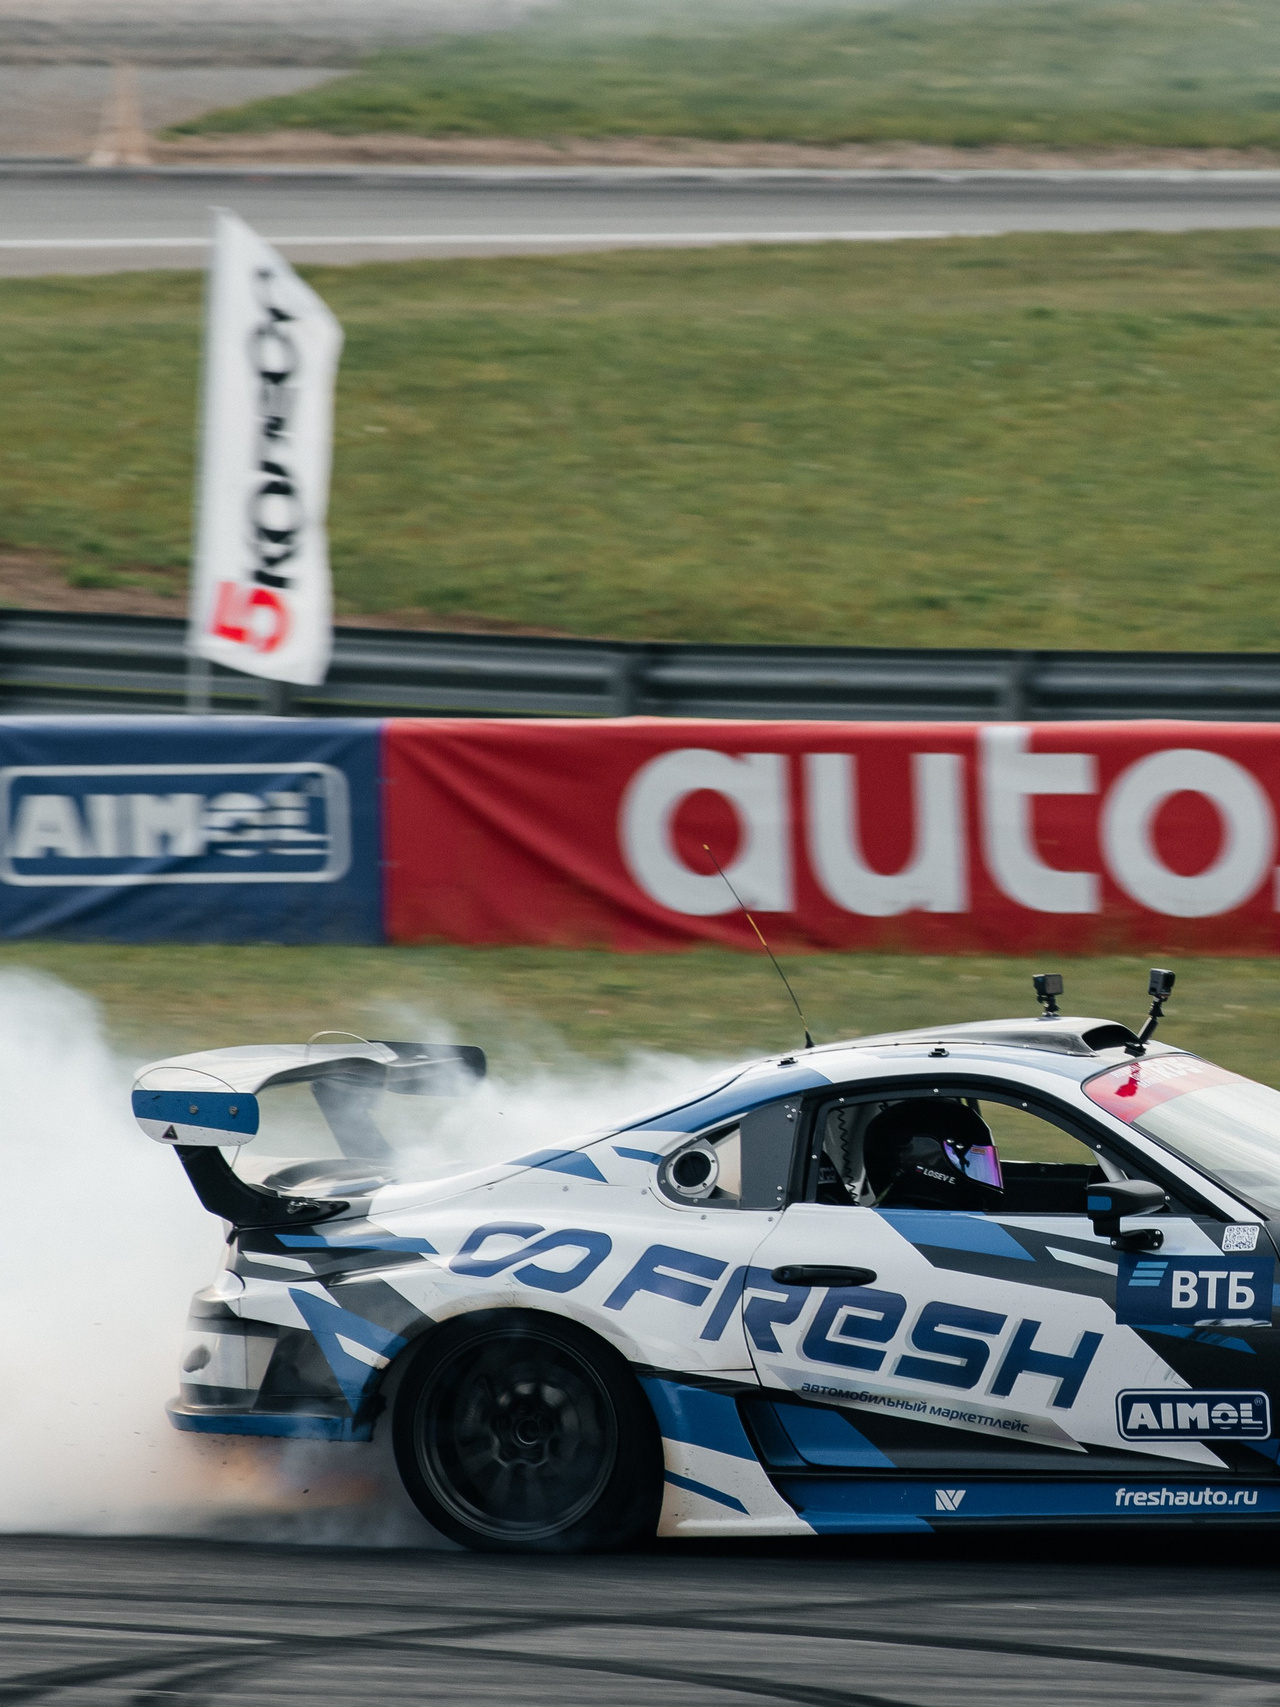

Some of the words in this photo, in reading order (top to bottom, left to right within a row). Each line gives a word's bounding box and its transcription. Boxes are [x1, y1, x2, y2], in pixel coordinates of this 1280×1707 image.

[1171, 1270, 1256, 1310] ВТБ
[800, 1381, 928, 1414] автомобильный
[929, 1405, 1030, 1434] маркетплейс
[1126, 1402, 1264, 1430] AIMOL
[1115, 1487, 1259, 1507] freshauto.ru
